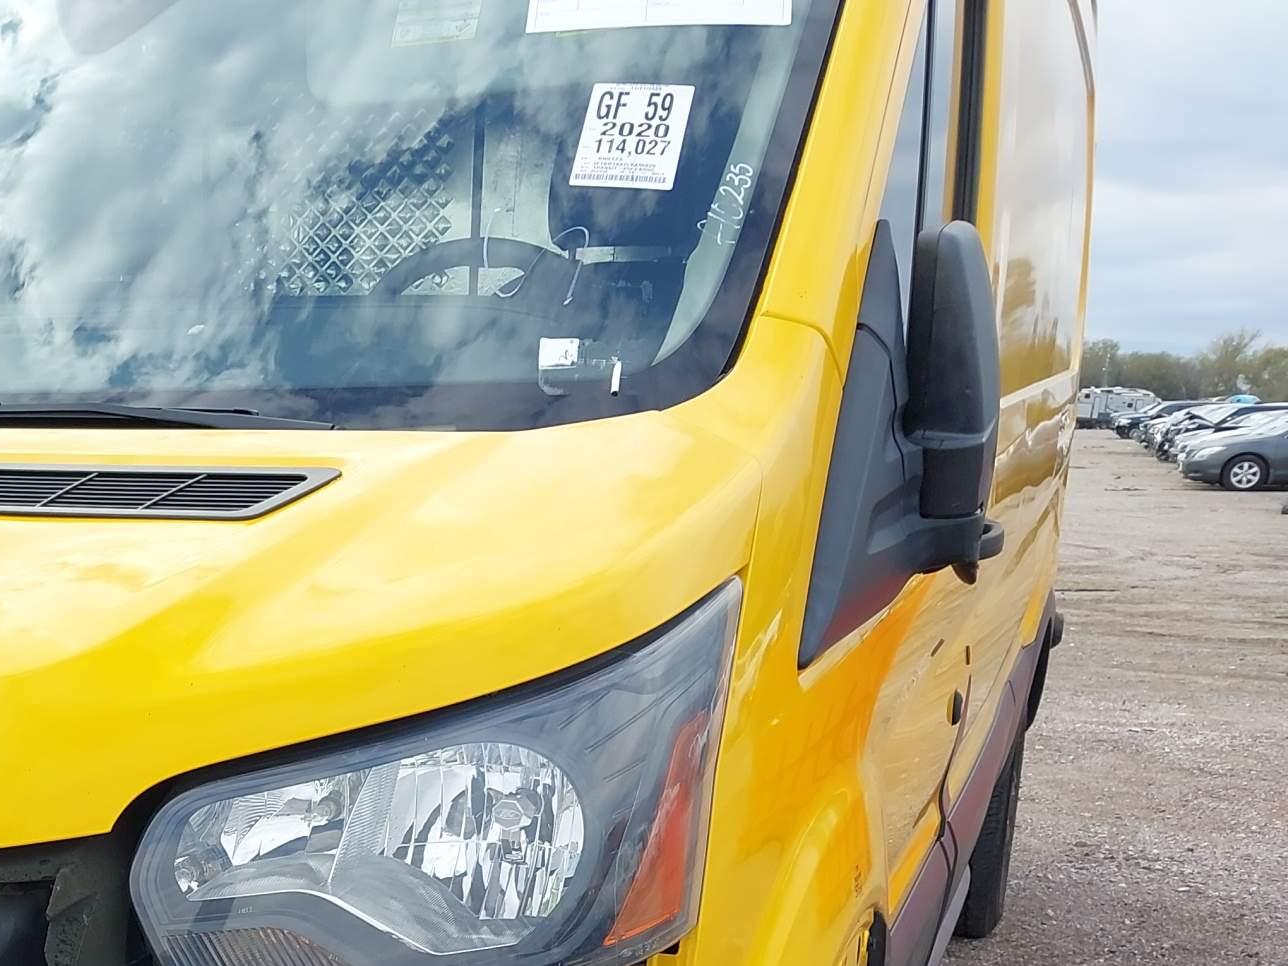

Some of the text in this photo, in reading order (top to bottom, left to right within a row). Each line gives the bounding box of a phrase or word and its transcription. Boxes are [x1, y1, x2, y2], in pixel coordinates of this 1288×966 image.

[596, 90, 674, 122] GF 59
[600, 121, 670, 138] 2020
[595, 138, 671, 156] 114,027
